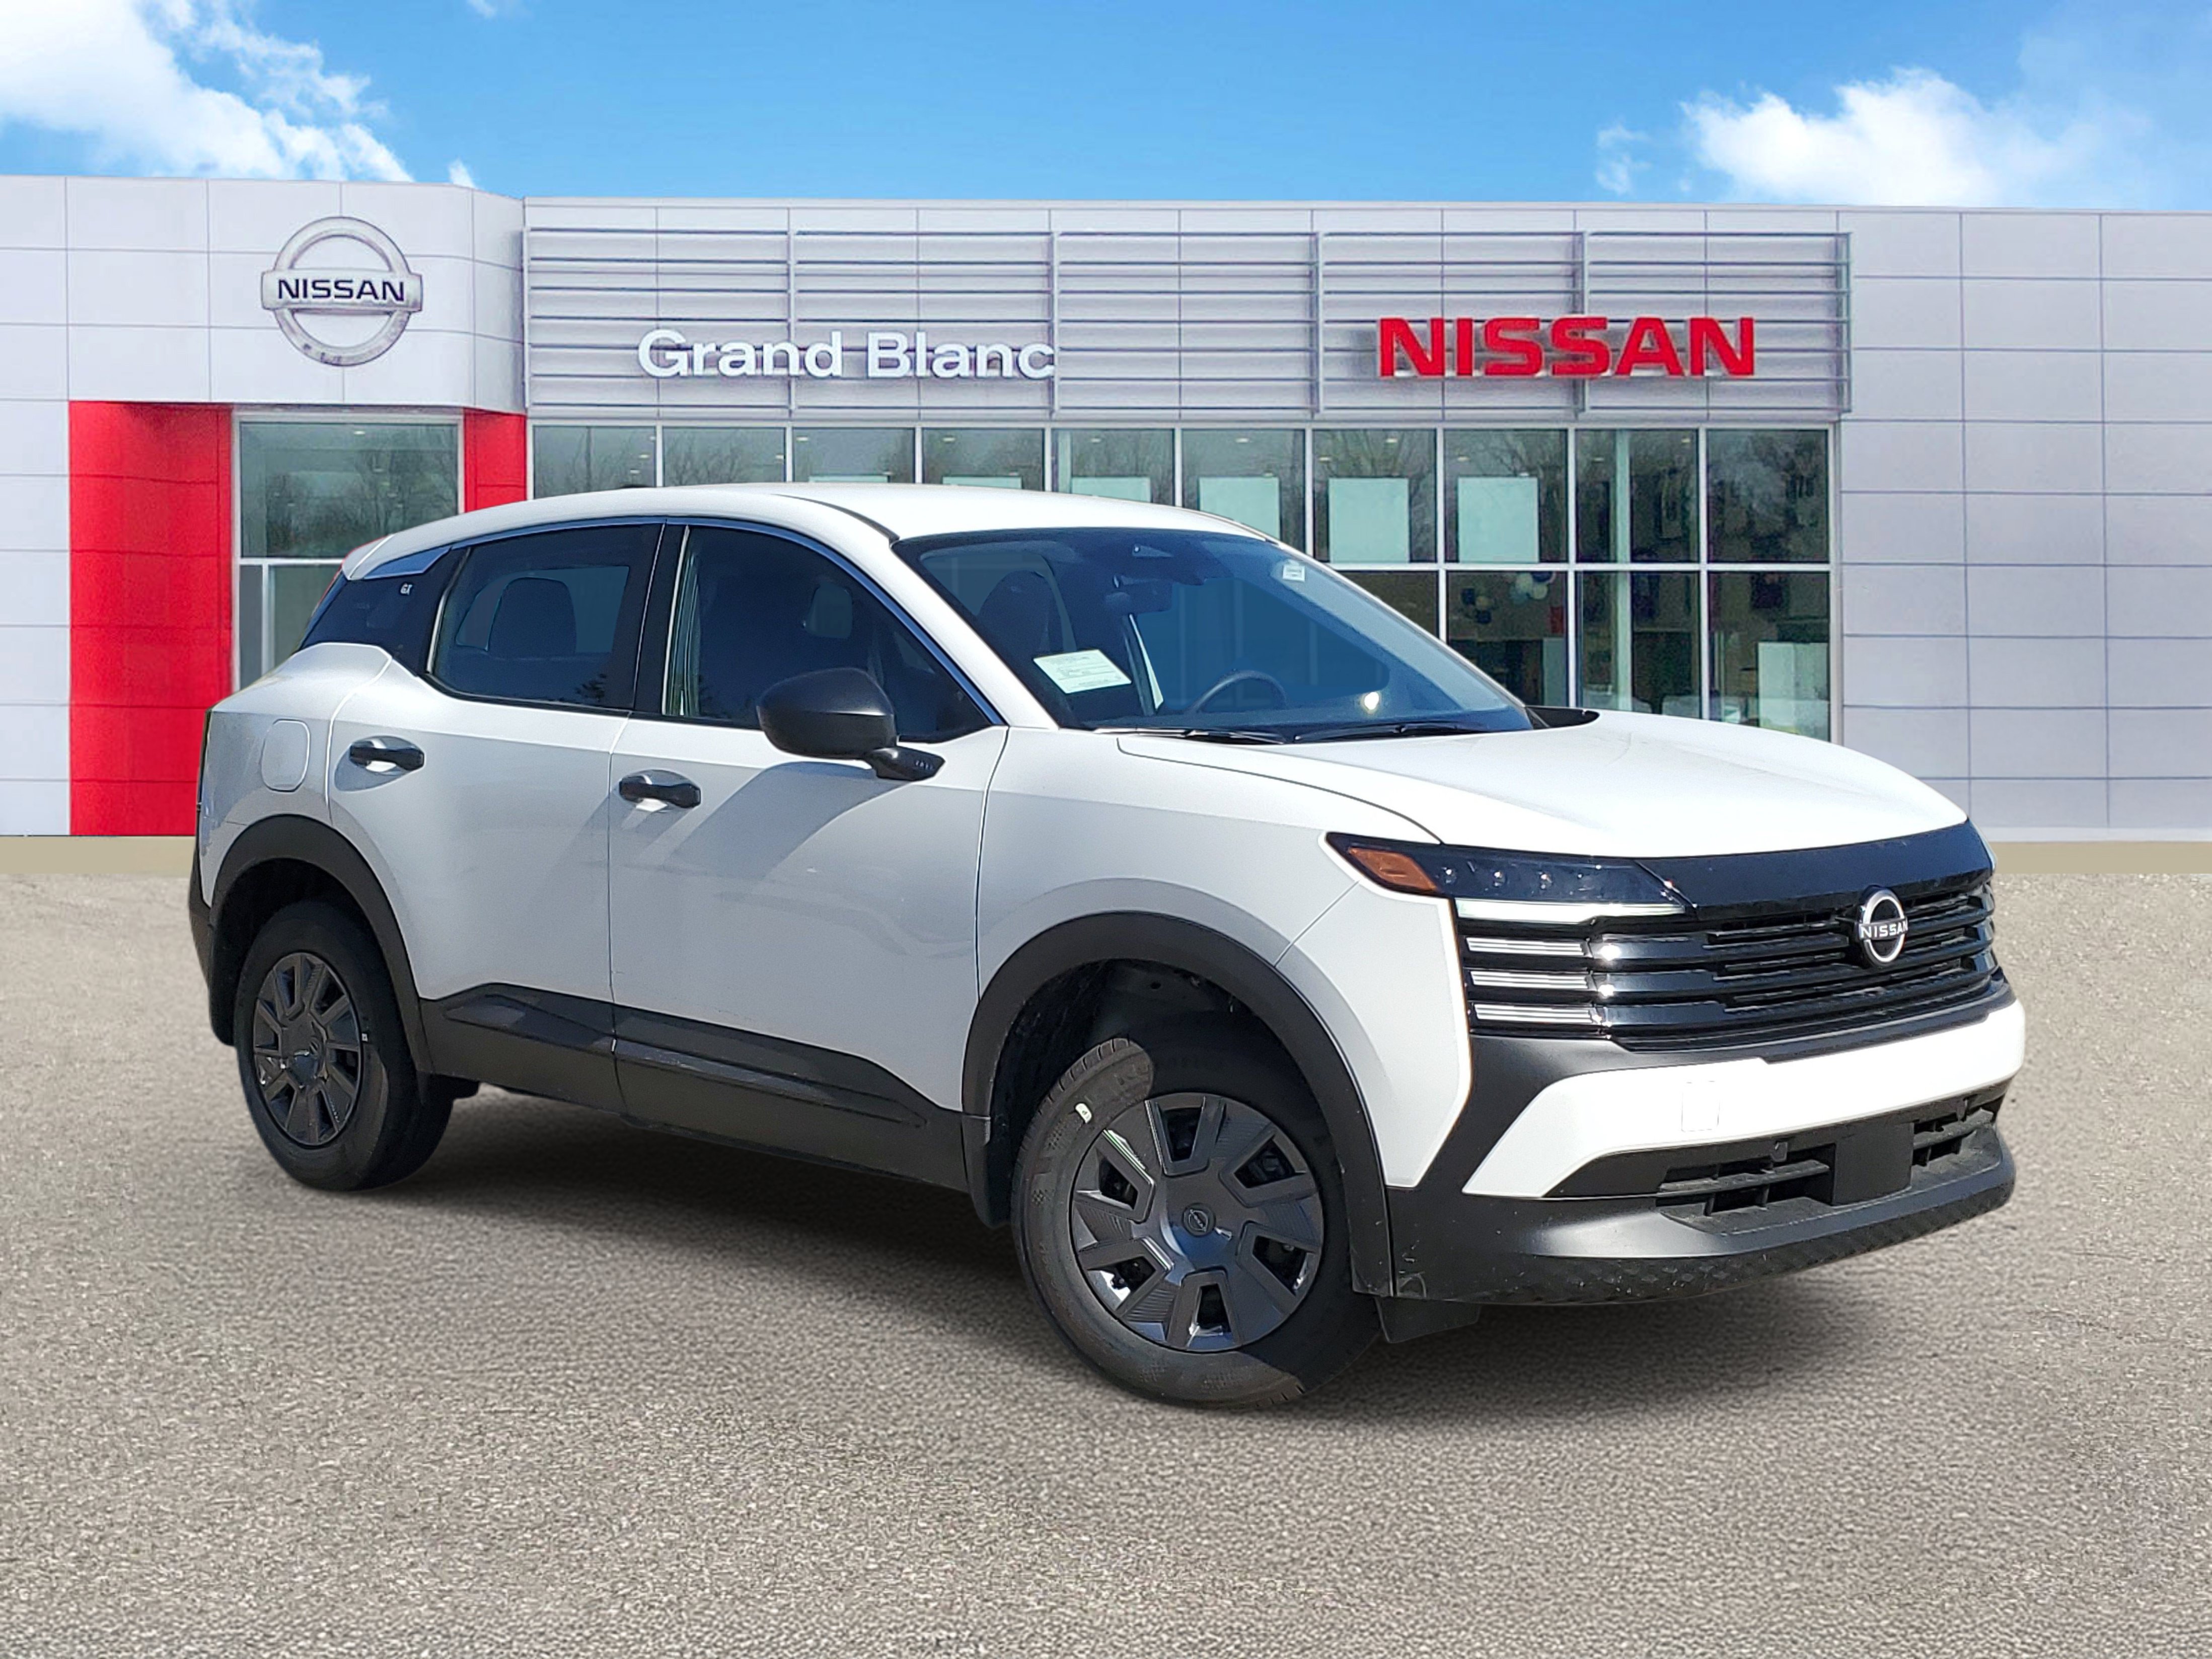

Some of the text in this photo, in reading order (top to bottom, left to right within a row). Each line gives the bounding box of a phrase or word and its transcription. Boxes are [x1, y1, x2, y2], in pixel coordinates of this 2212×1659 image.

[278, 278, 405, 302] NISSAN
[637, 329, 1055, 380] Grand Blanc
[1378, 317, 1755, 377] NISSAN
[1861, 919, 1908, 938] NISSAN
